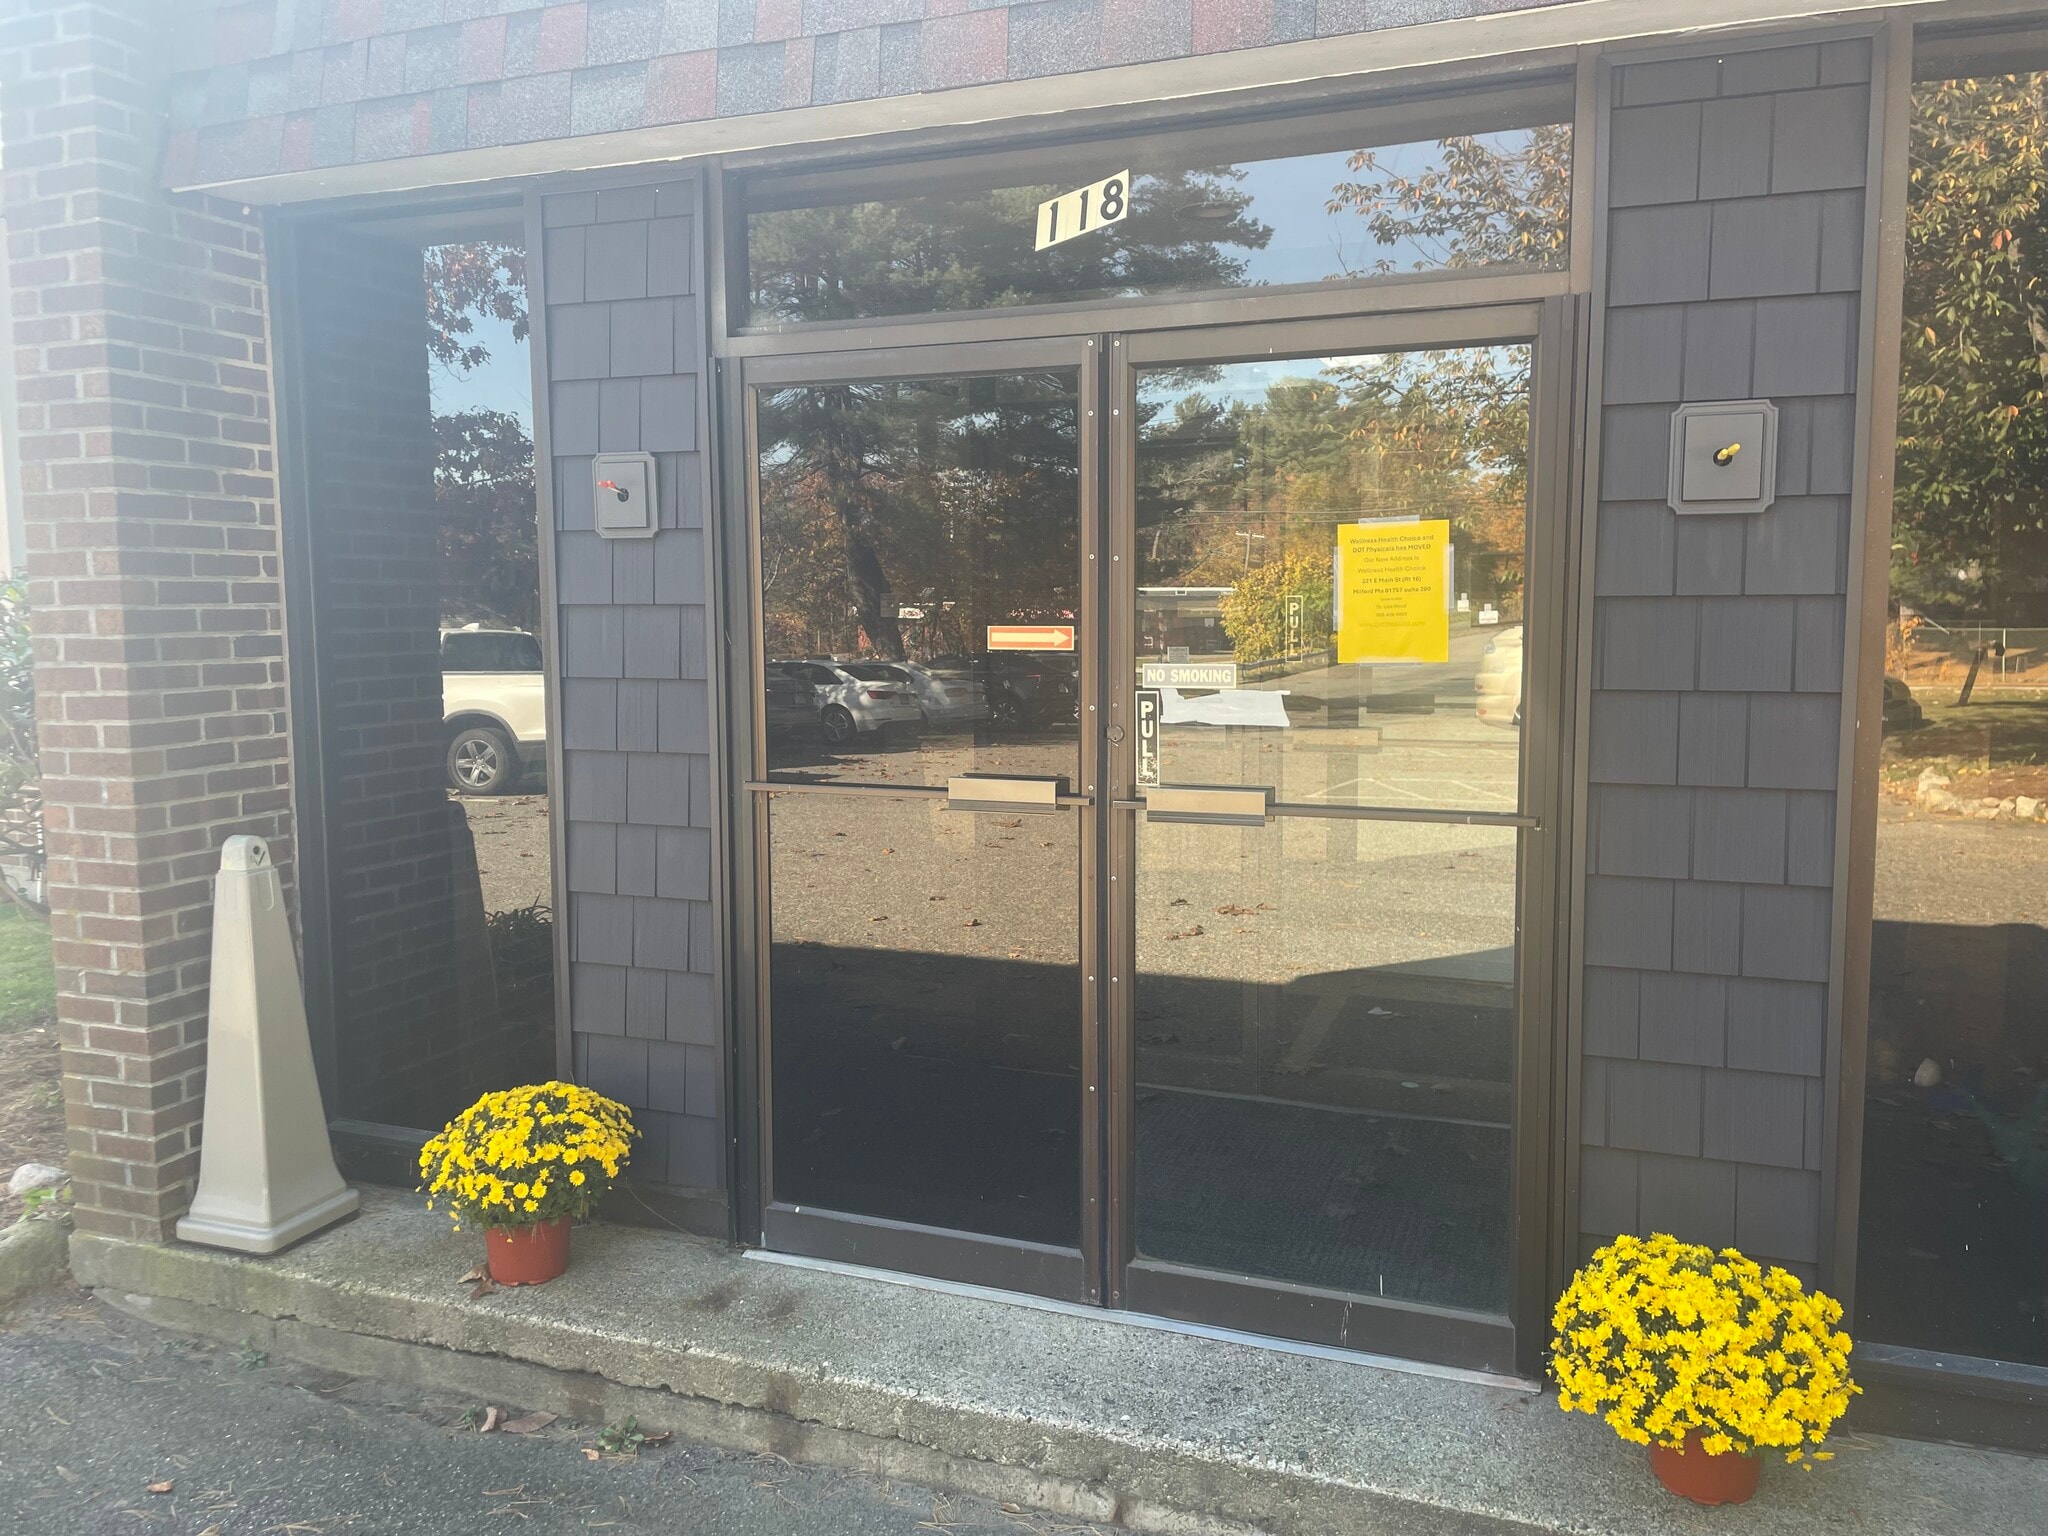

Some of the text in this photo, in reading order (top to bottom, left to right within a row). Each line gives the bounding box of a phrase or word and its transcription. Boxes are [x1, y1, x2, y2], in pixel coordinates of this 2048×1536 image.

[1049, 179, 1124, 243] 118
[1366, 545, 1394, 553] Physicals
[1289, 602, 1299, 656] PULL
[1147, 669, 1231, 682] NO SMOKING
[1140, 701, 1154, 779] PULL
